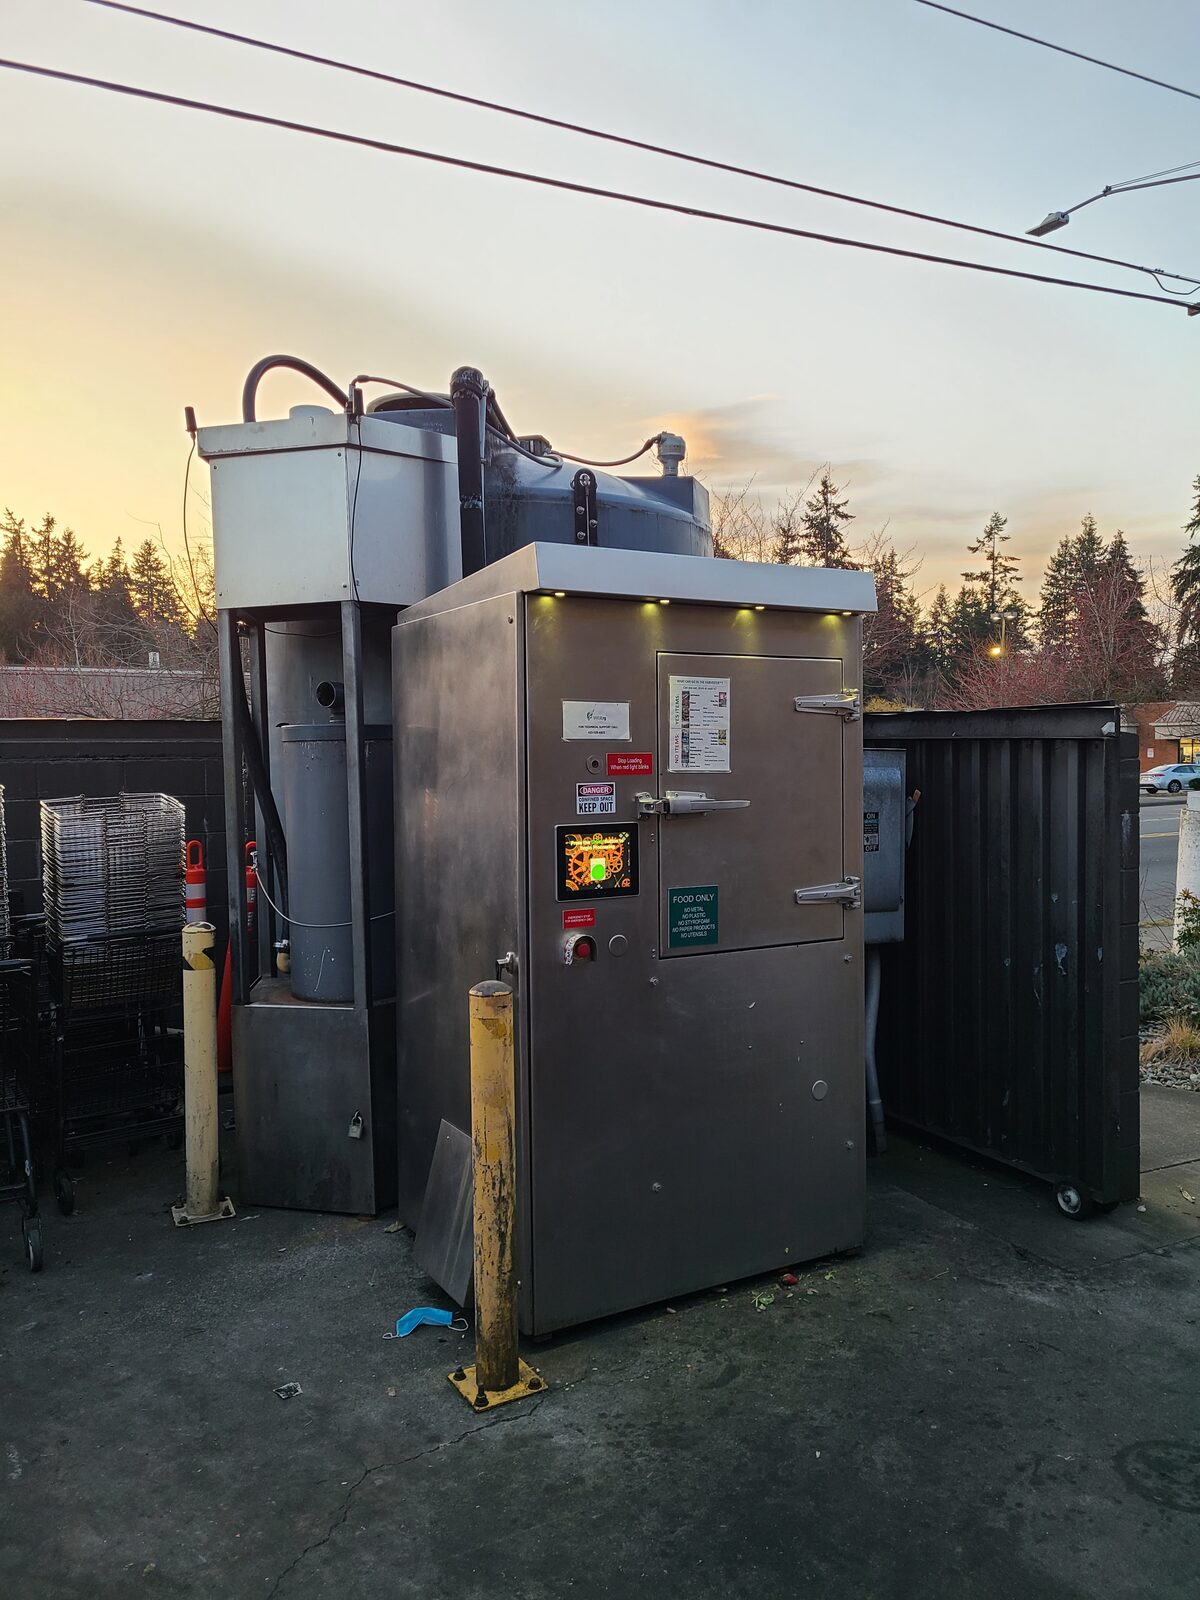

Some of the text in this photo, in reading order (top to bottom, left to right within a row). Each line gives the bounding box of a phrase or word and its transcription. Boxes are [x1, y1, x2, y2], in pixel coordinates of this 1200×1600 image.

[579, 802, 613, 813] KEEP OUT
[673, 894, 714, 903] FOOD ONLY
